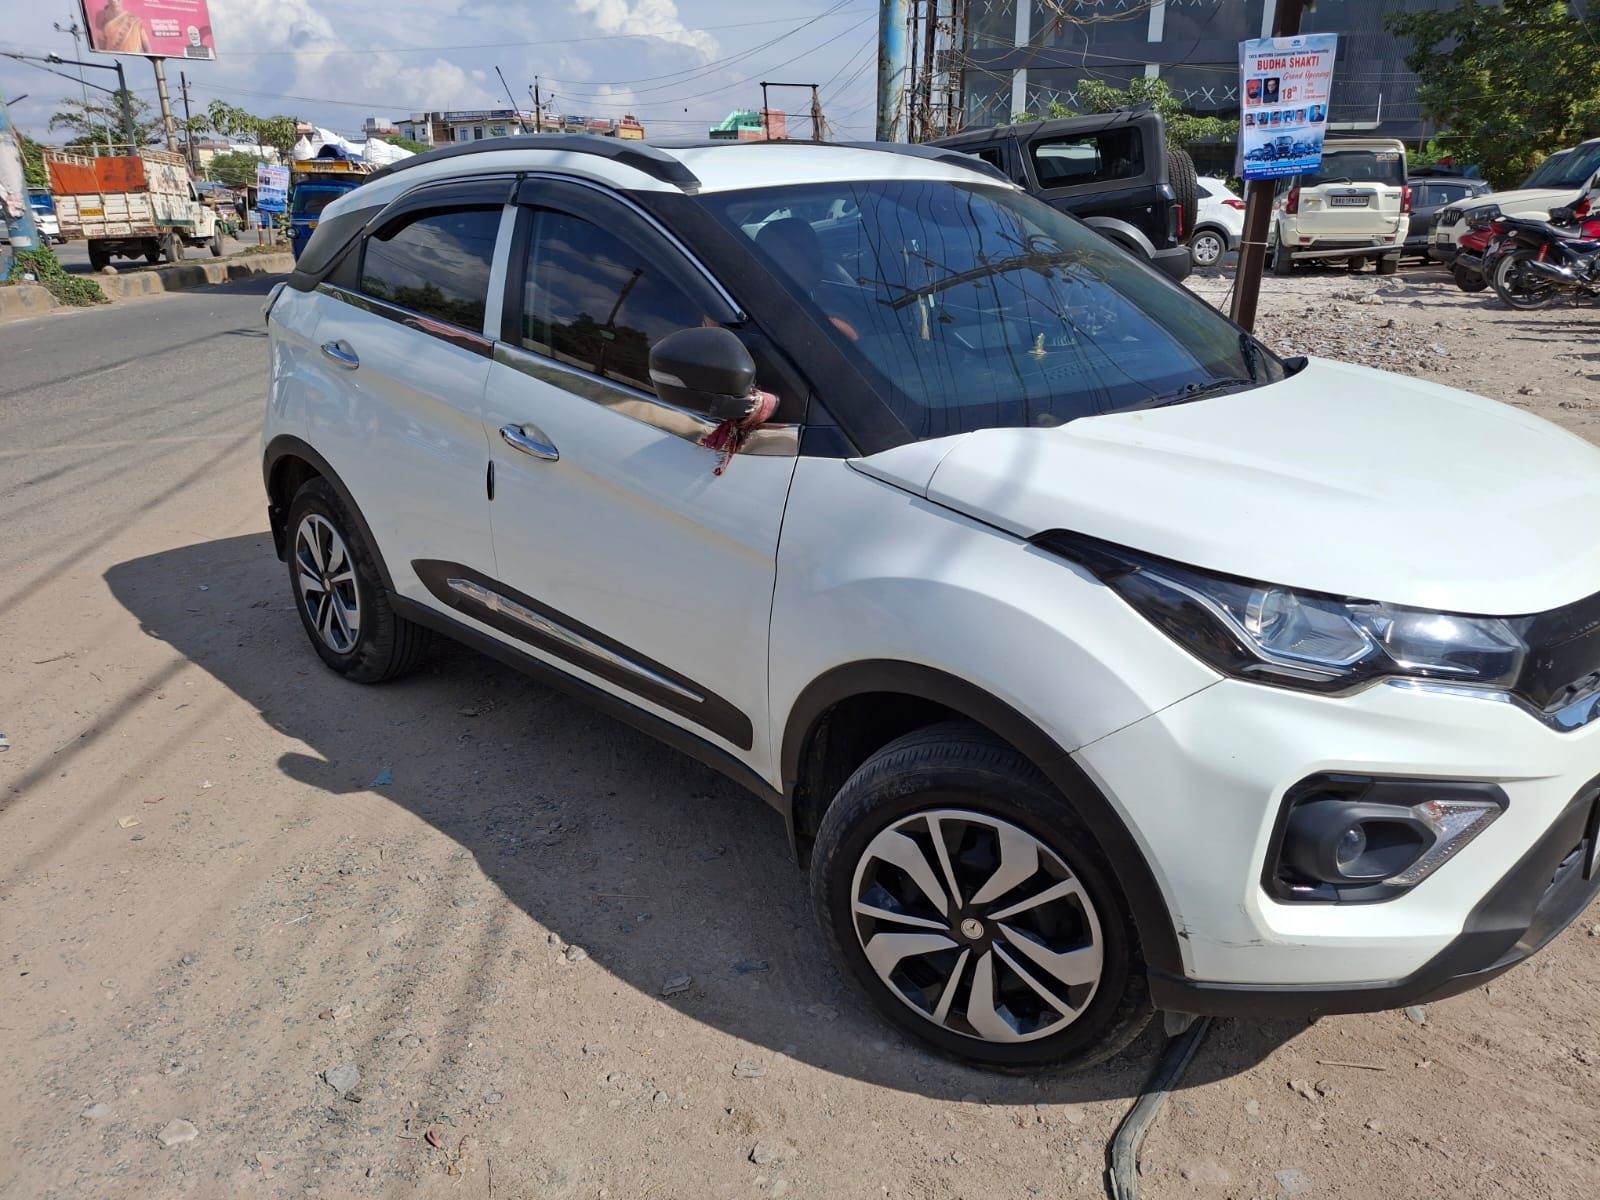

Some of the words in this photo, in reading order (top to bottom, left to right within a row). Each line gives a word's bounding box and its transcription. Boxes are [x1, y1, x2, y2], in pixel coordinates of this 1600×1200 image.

[1257, 58, 1287, 71] BUDHA
[1289, 56, 1320, 68] SHAKTI
[1282, 71, 1303, 81] Grand
[1305, 70, 1330, 81] Opening
